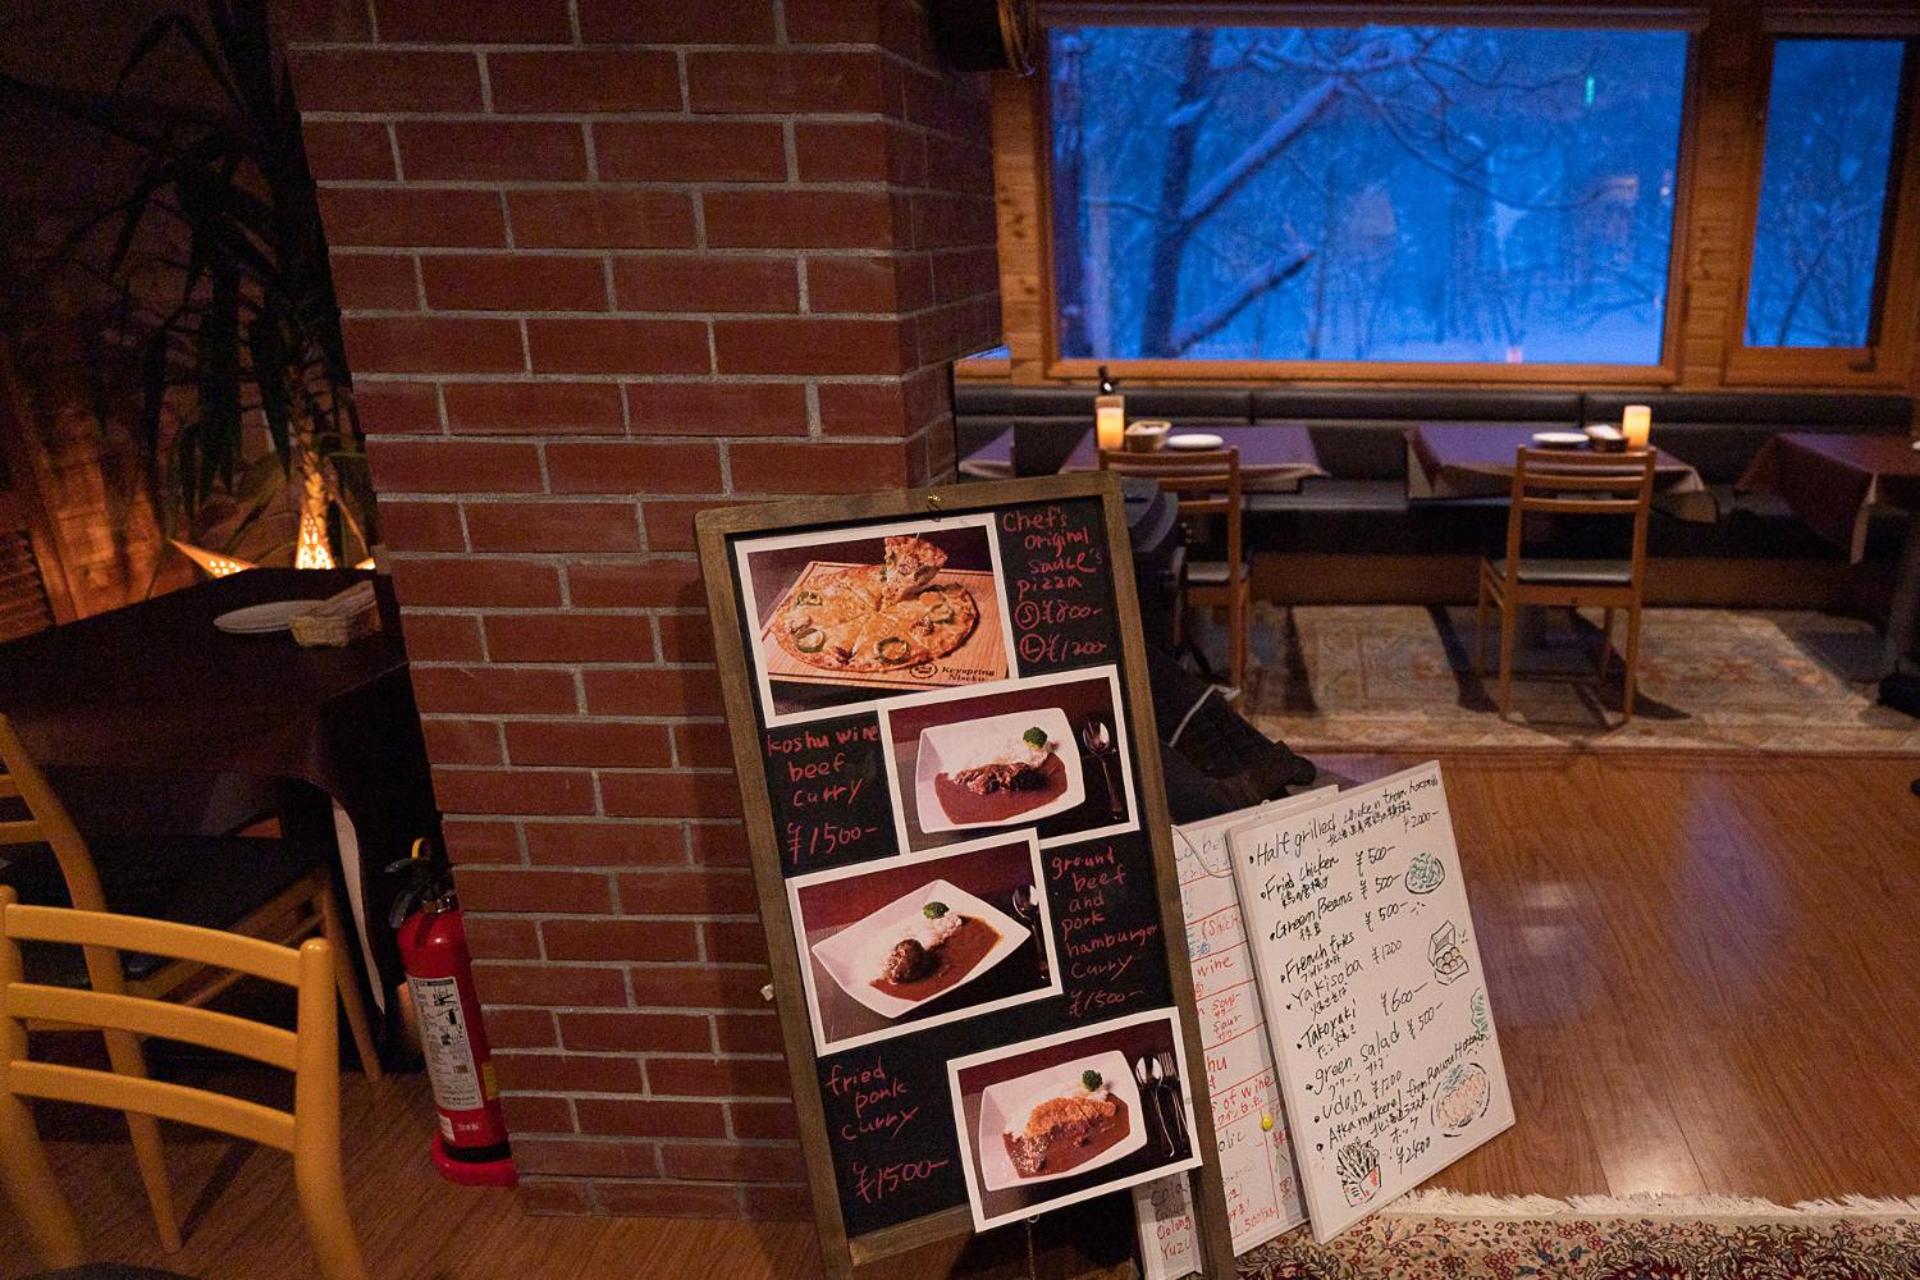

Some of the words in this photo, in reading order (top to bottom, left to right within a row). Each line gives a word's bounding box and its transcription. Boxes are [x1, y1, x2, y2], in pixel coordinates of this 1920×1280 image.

[788, 753, 846, 782] beef
[1256, 832, 1292, 866] Half
[1072, 864, 1126, 892] beef
[1264, 872, 1295, 900] Fried
[1069, 890, 1105, 912] and
[1061, 913, 1105, 941] pork
[1285, 944, 1328, 983] French
[825, 1055, 886, 1095] fried
